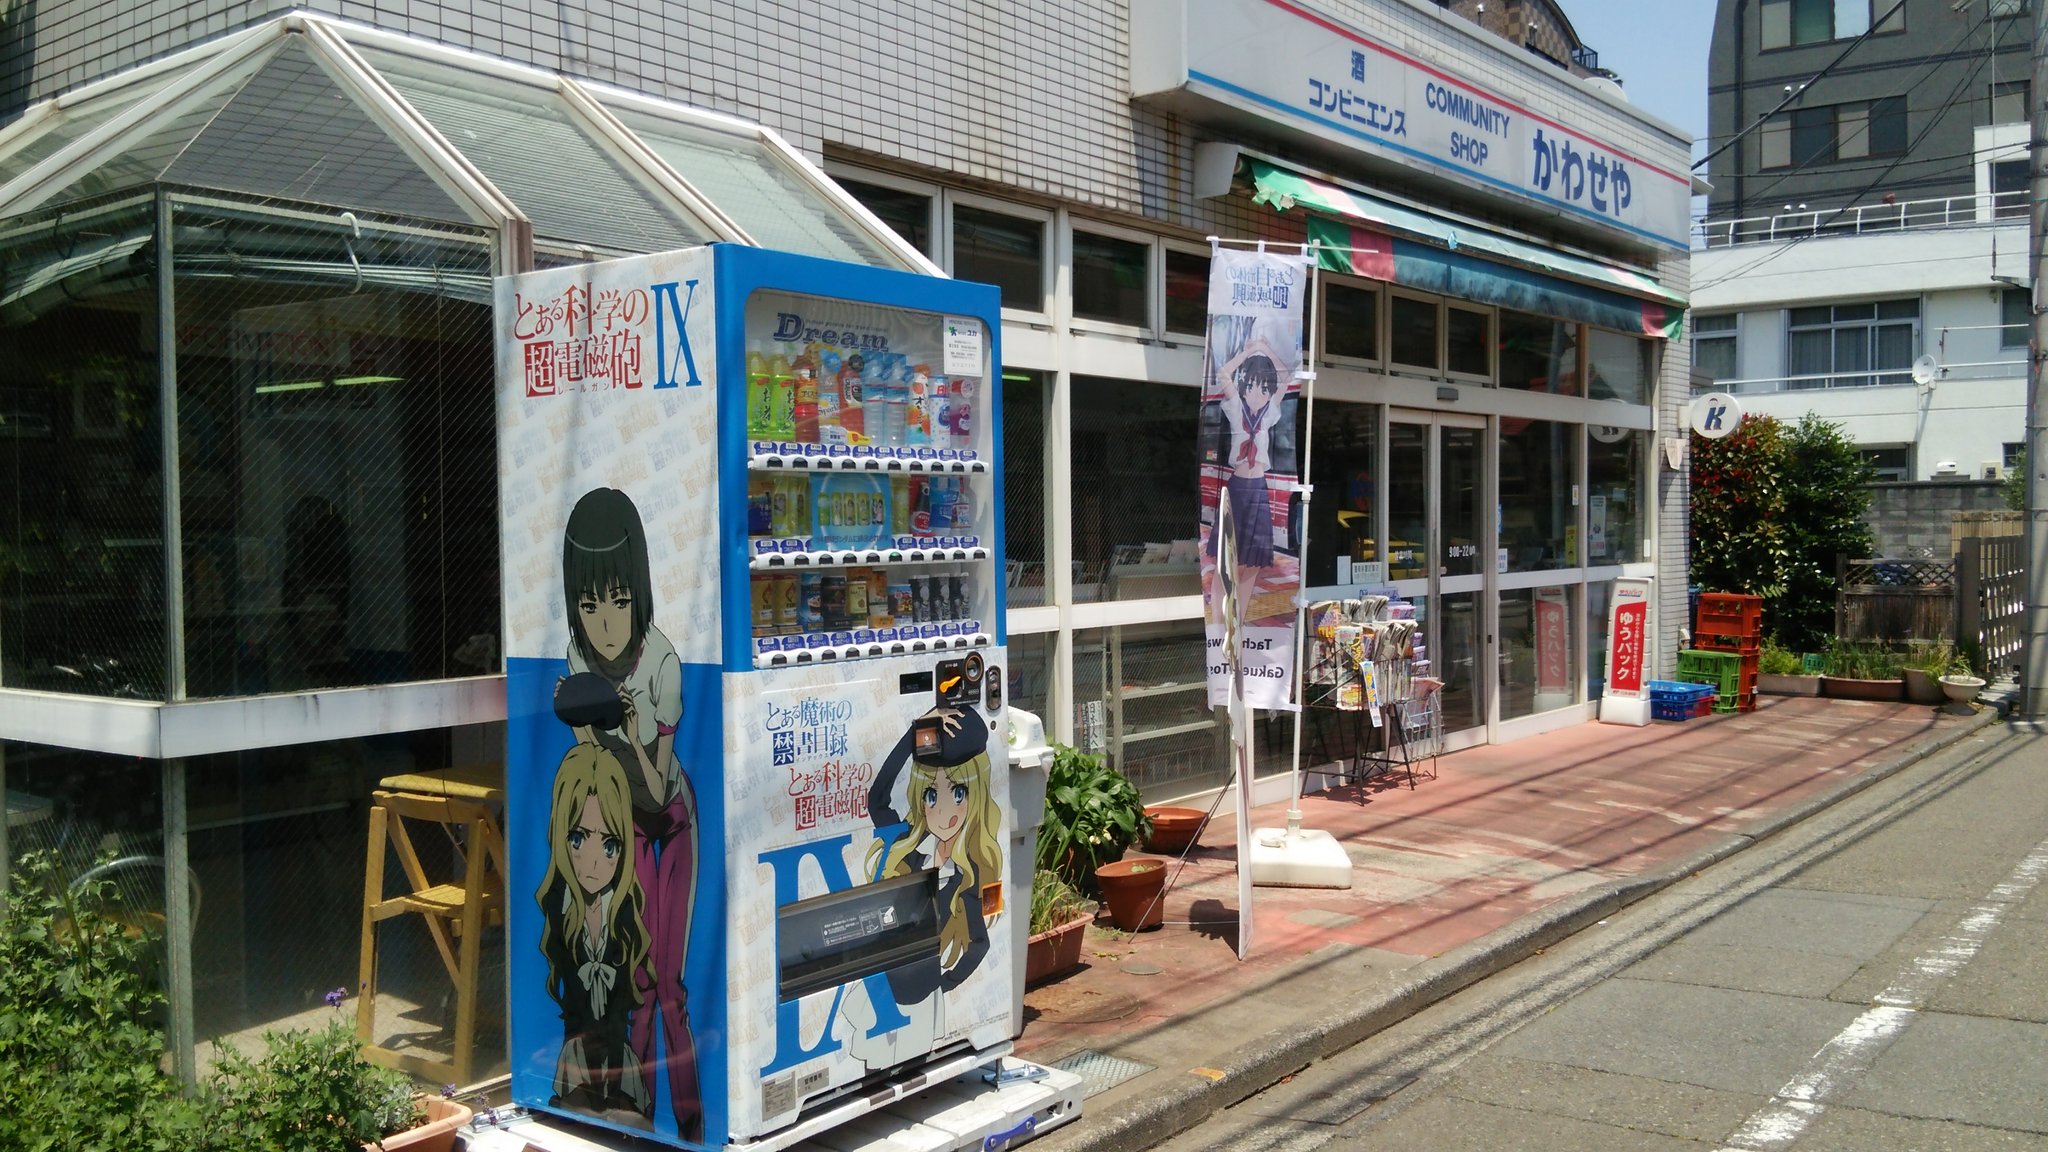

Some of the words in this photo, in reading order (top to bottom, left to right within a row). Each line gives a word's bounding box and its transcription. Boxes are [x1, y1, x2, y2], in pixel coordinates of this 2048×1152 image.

[1351, 50, 1366, 83] 酒
[1308, 77, 1407, 138] コンビニエンス
[1425, 82, 1510, 139] COMMUNITY
[1450, 131, 1488, 166] SHOP
[1532, 128, 1632, 216] かわせや
[513, 281, 650, 341] とある科学の
[772, 312, 889, 352] Dream
[650, 279, 702, 390] IX
[524, 328, 643, 398] 超電磁砲
[1703, 406, 1727, 431] K
[1617, 611, 1634, 681] ゆうパック
[765, 696, 853, 731] とある魔術の
[773, 723, 848, 767] 禁書目録
[788, 759, 872, 797] とある科学の
[794, 785, 869, 831] 超電磁砲
